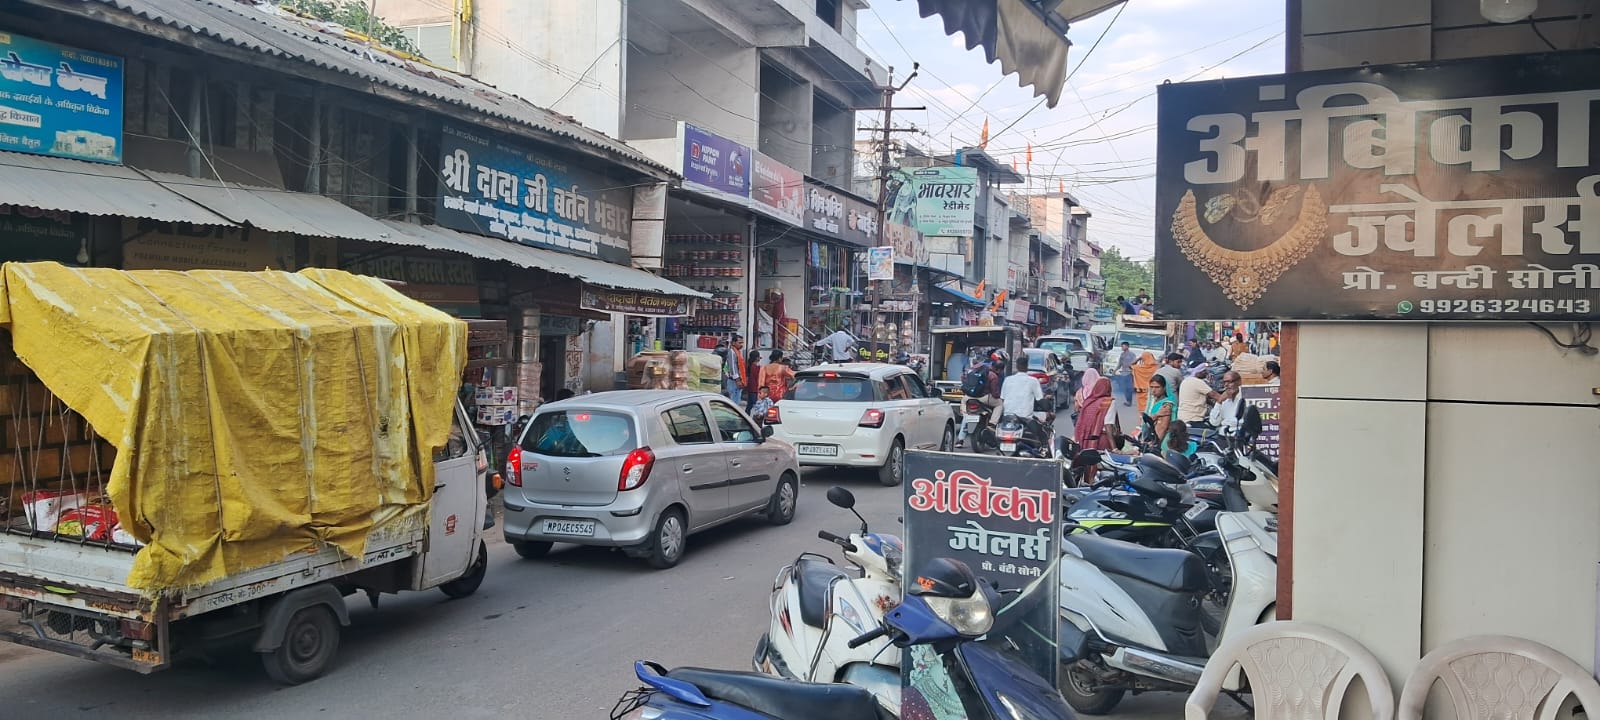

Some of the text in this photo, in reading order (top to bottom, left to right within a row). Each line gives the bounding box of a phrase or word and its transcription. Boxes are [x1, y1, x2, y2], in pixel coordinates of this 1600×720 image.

[1183, 82, 1600, 185] अंबिका
[441, 148, 471, 194] श्री
[476, 164, 520, 207] दादा
[524, 173, 549, 214] जी
[553, 184, 590, 225] बर्तन
[594, 193, 630, 235] भंडार
[918, 182, 975, 199] भावसार
[943, 200, 970, 212] रेडीमेड
[1328, 174, 1600, 257] ज्वेलर्स
[1342, 263, 1600, 290] प्रो. बन्टी सोनी
[1420, 299, 1590, 314] 9926324643
[908, 469, 1057, 524] अंबिका
[547, 520, 594, 535] MP04EC5545
[947, 520, 1051, 561] ज्वेलर्स
[981, 560, 996, 573] प्रो.
[1017, 564, 1042, 578] सोनी
